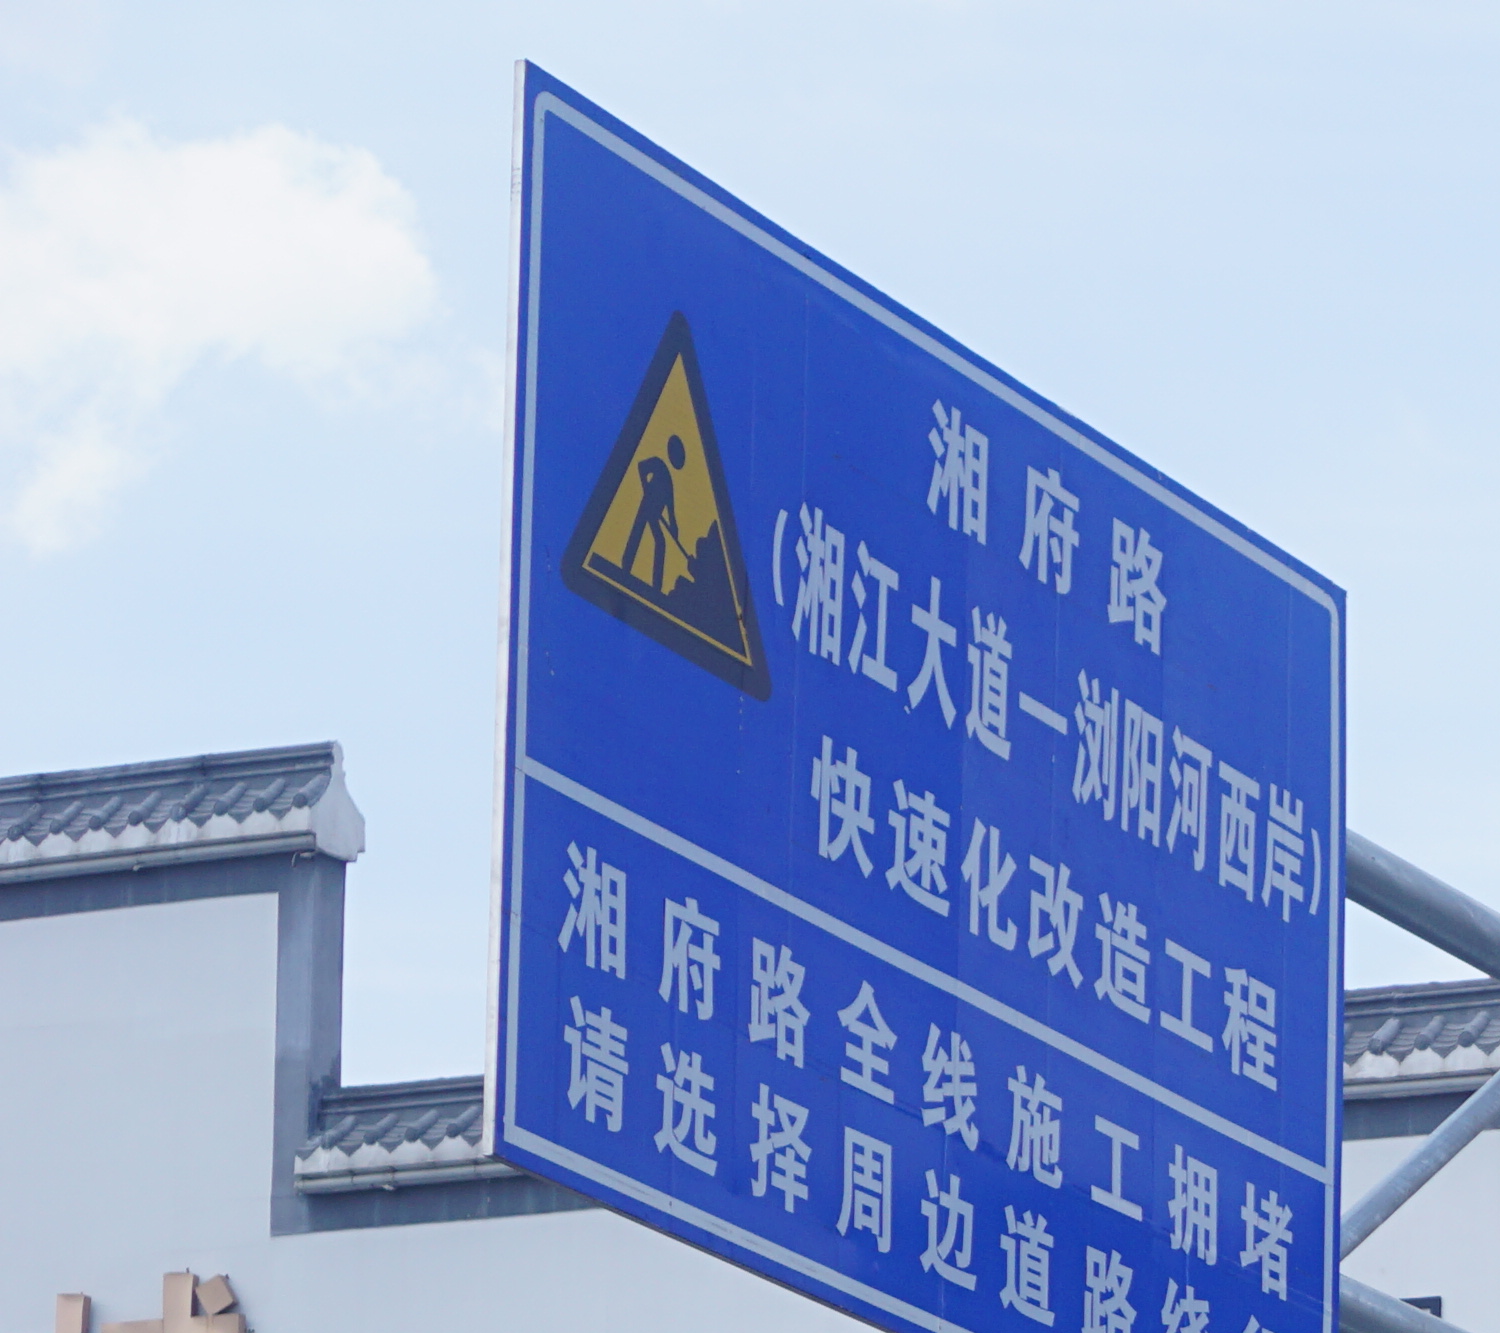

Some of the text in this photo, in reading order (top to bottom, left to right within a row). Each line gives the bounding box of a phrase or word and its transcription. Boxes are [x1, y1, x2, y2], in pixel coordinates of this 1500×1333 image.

[927, 399, 1166, 655] 湘府路
[558, 841, 1293, 1301] 湘府路全线施工拥堵
[811, 735, 1278, 1092] 快速化改造工程
